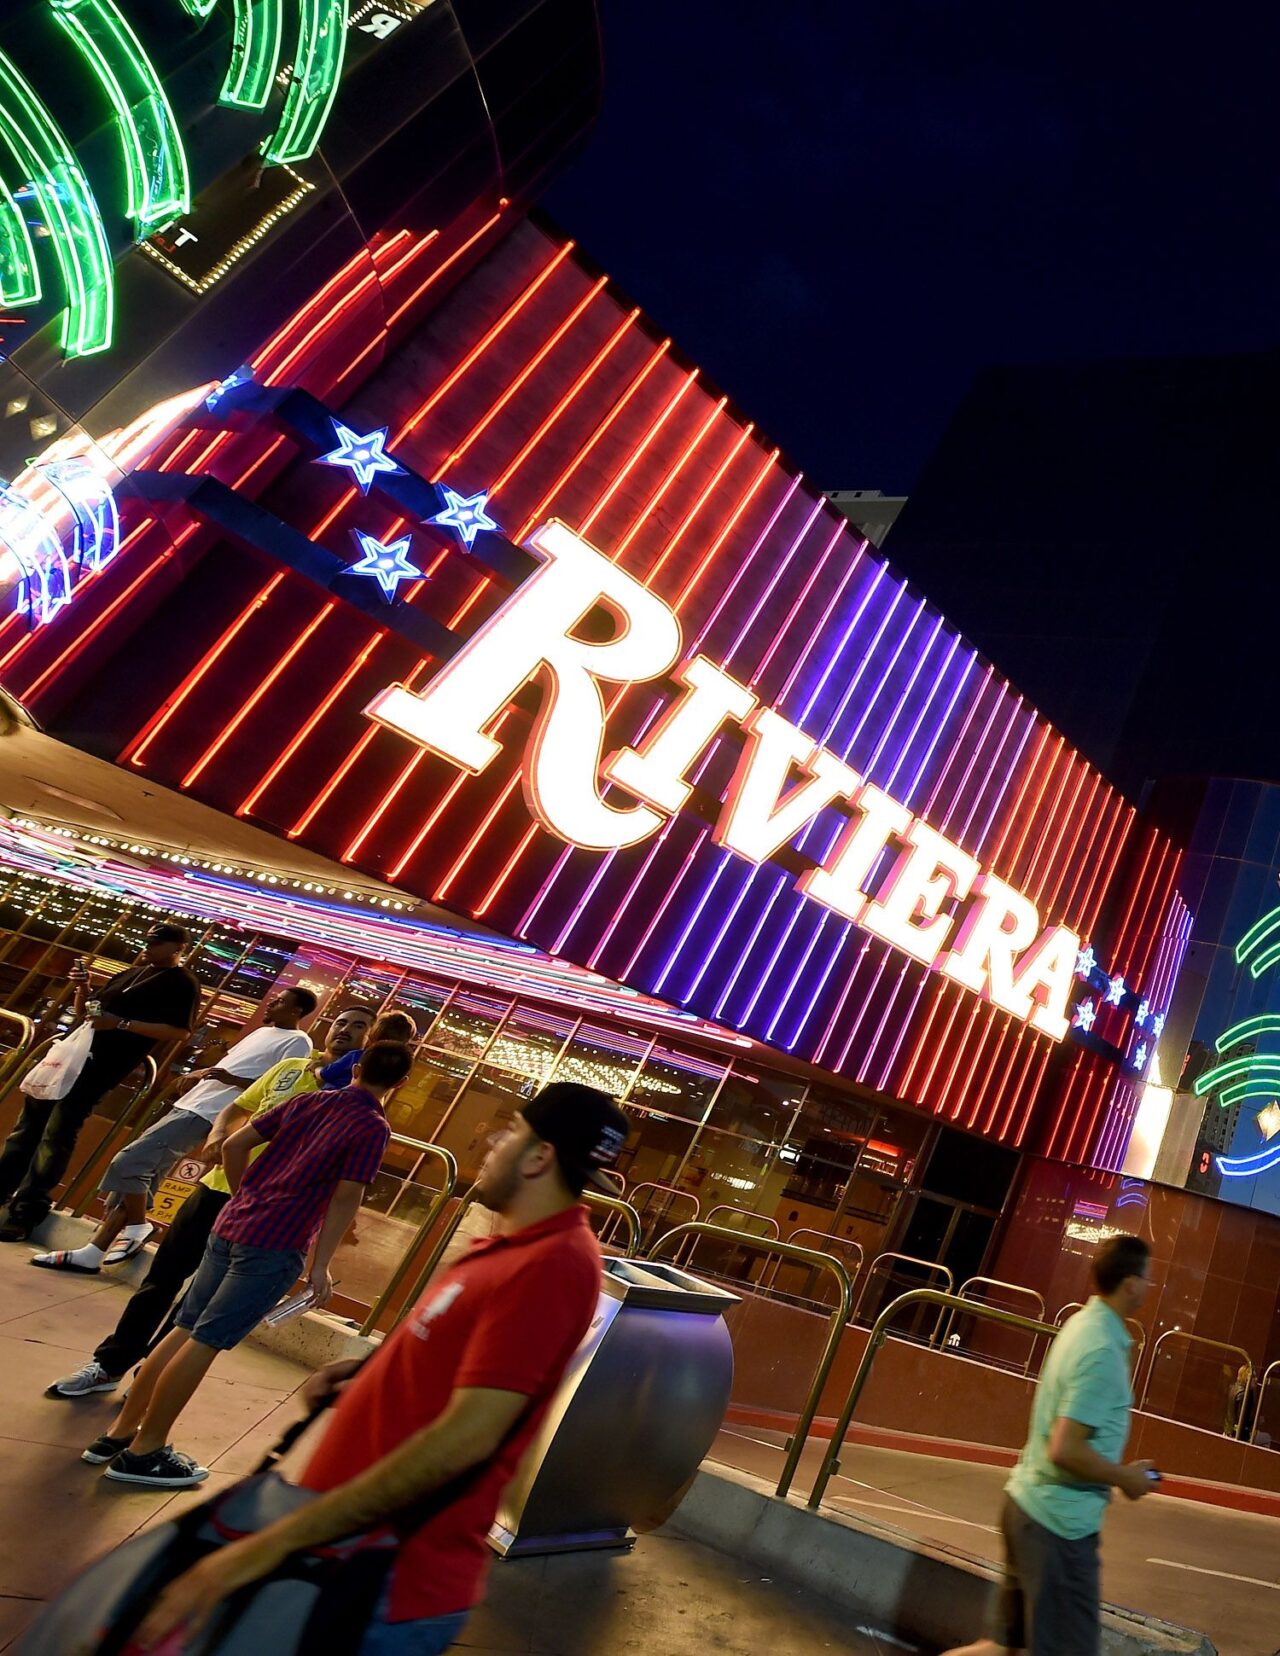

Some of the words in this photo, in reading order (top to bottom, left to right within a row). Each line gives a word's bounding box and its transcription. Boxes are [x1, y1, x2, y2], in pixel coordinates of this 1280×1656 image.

[362, 517, 1082, 1044] RIVIERA
[165, 1182, 191, 1193] RAMP
[160, 1197, 175, 1209] 5
